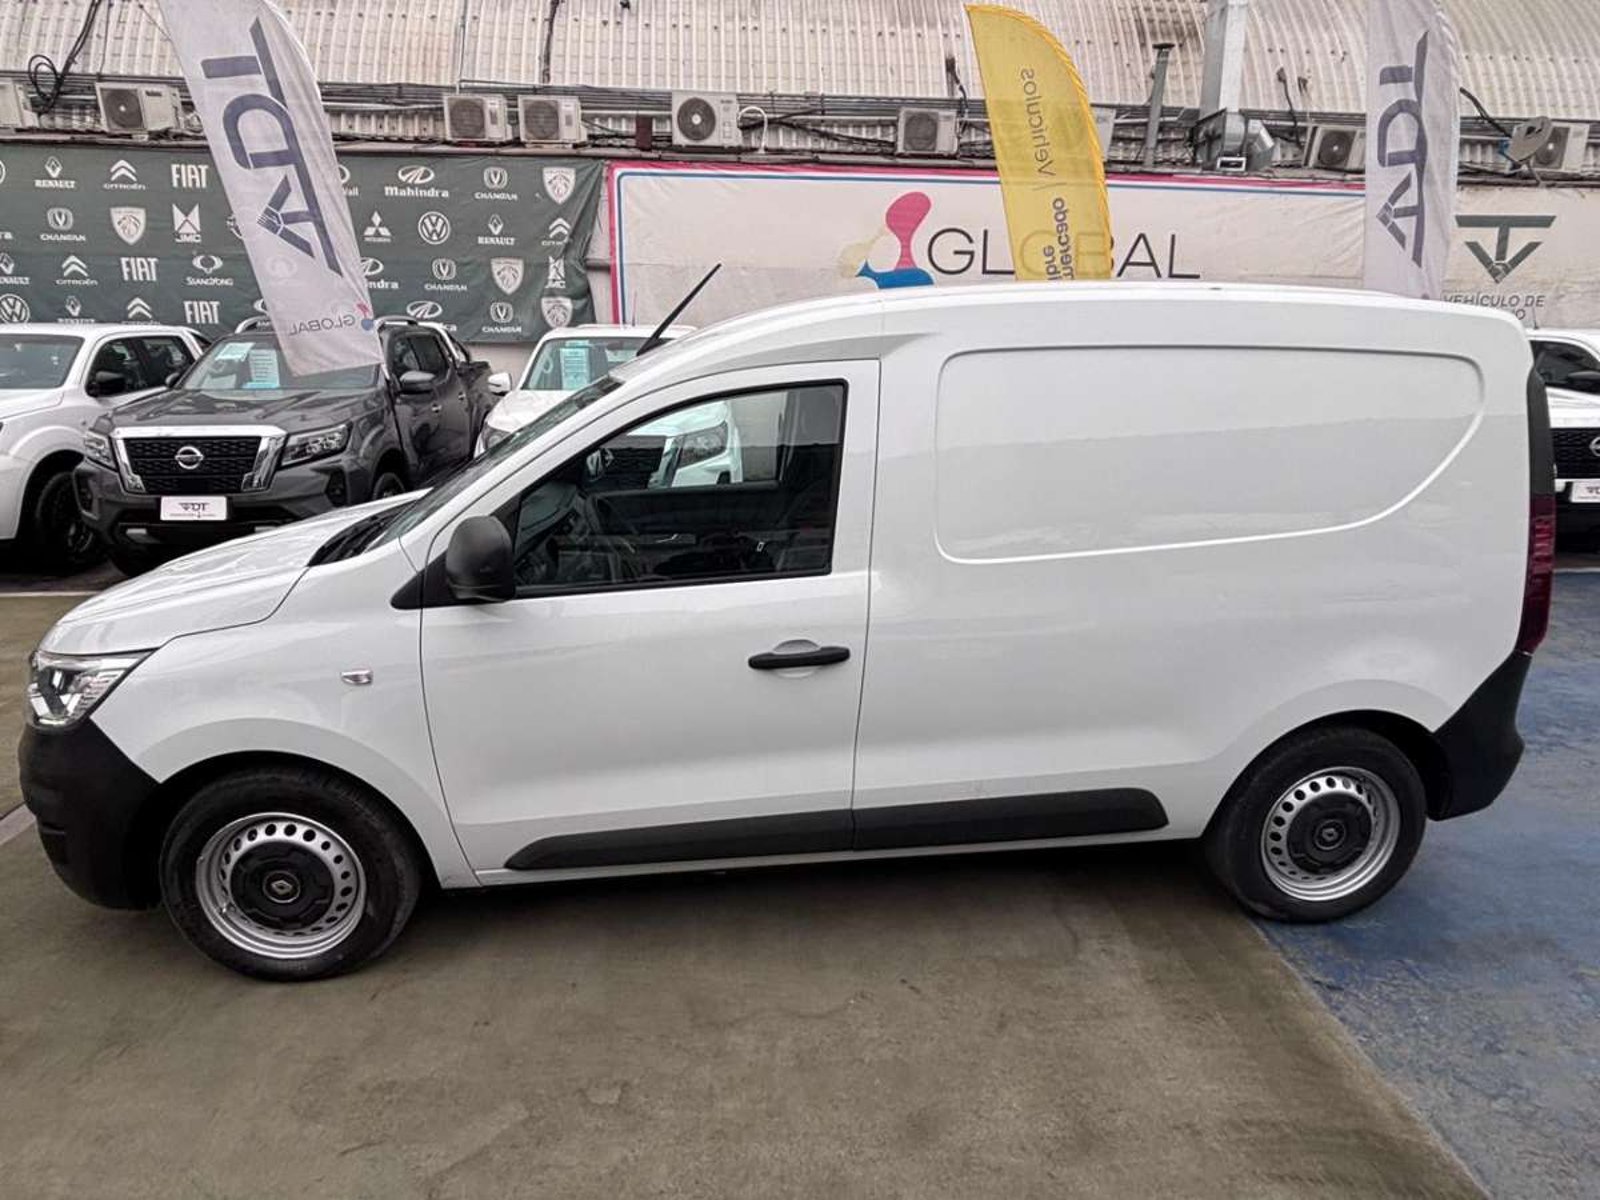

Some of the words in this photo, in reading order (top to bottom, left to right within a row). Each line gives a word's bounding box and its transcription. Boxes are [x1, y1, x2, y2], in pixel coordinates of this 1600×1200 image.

[170, 163, 209, 189] FIAT
[119, 256, 159, 282] FIAT
[182, 300, 221, 325] FIAT
[1524, 295, 1546, 308] DE
